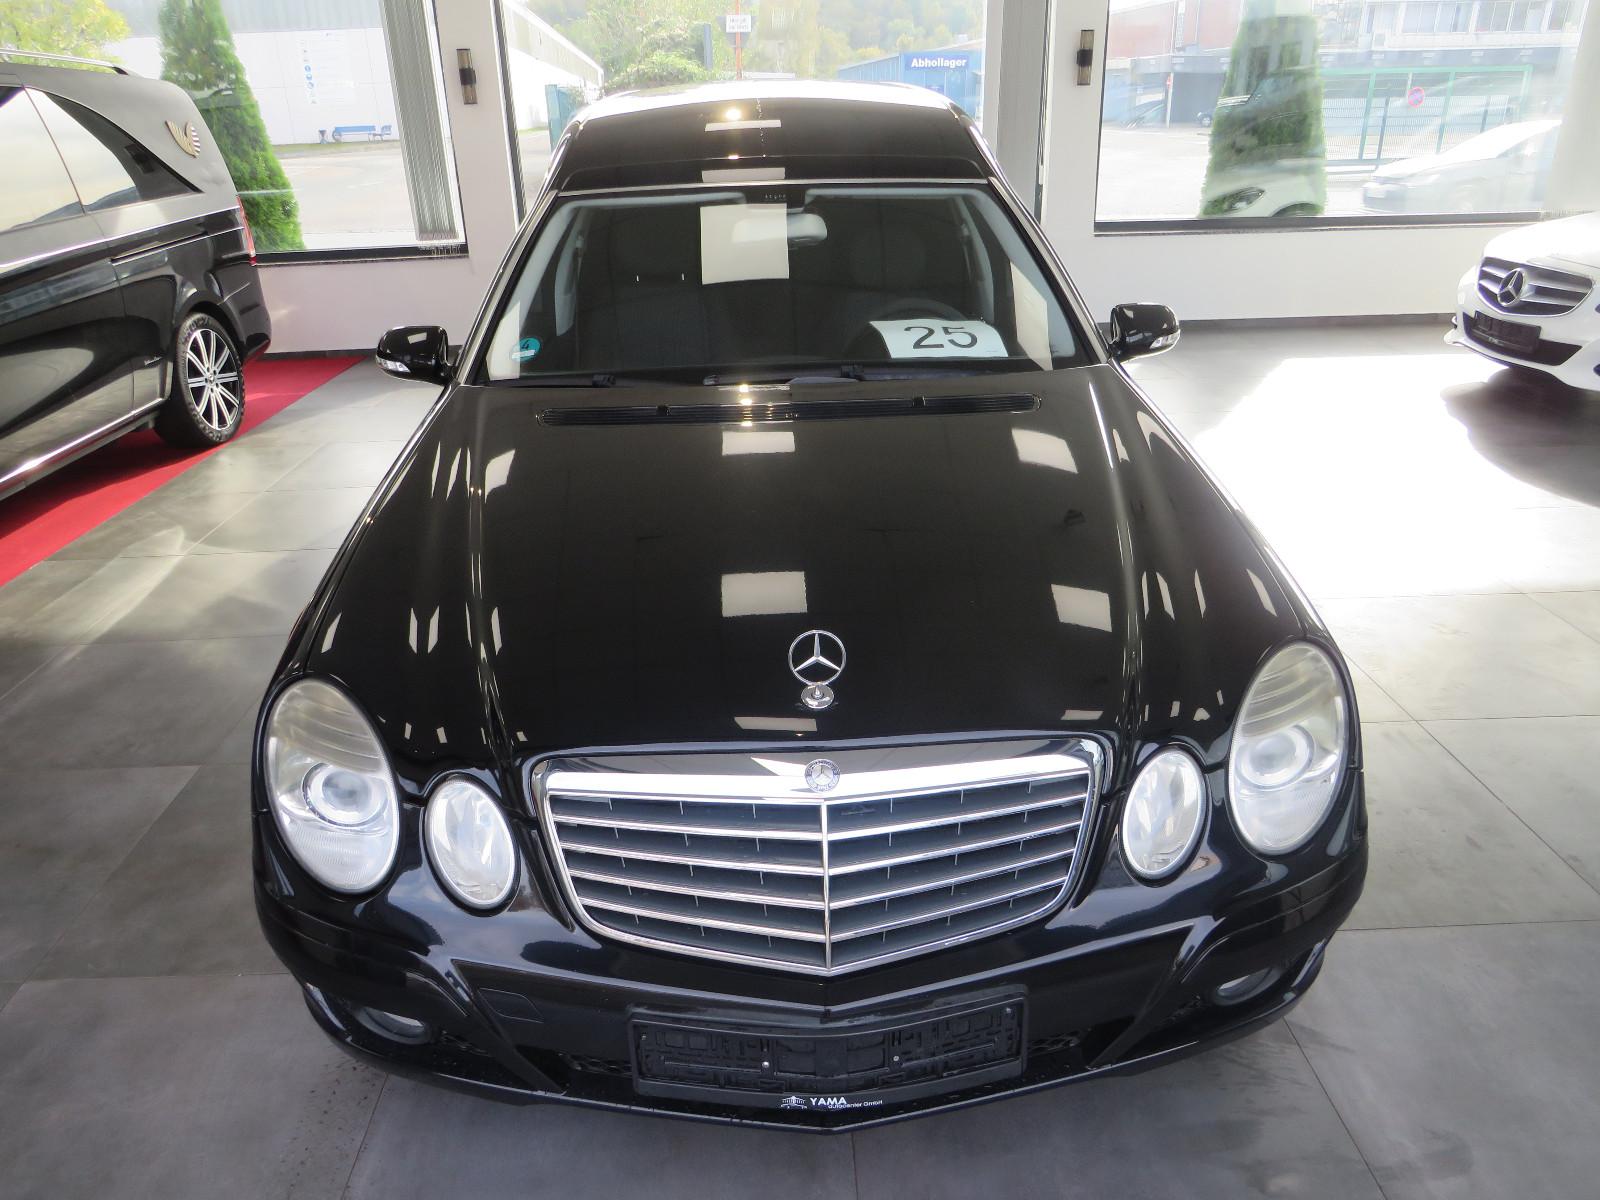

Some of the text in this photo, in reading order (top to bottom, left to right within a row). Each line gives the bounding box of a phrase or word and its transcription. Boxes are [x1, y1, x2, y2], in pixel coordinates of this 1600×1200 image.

[911, 57, 967, 69] Abhollager
[903, 326, 978, 349] 25
[521, 339, 530, 349] 4
[809, 1097, 847, 1106] YAMA
